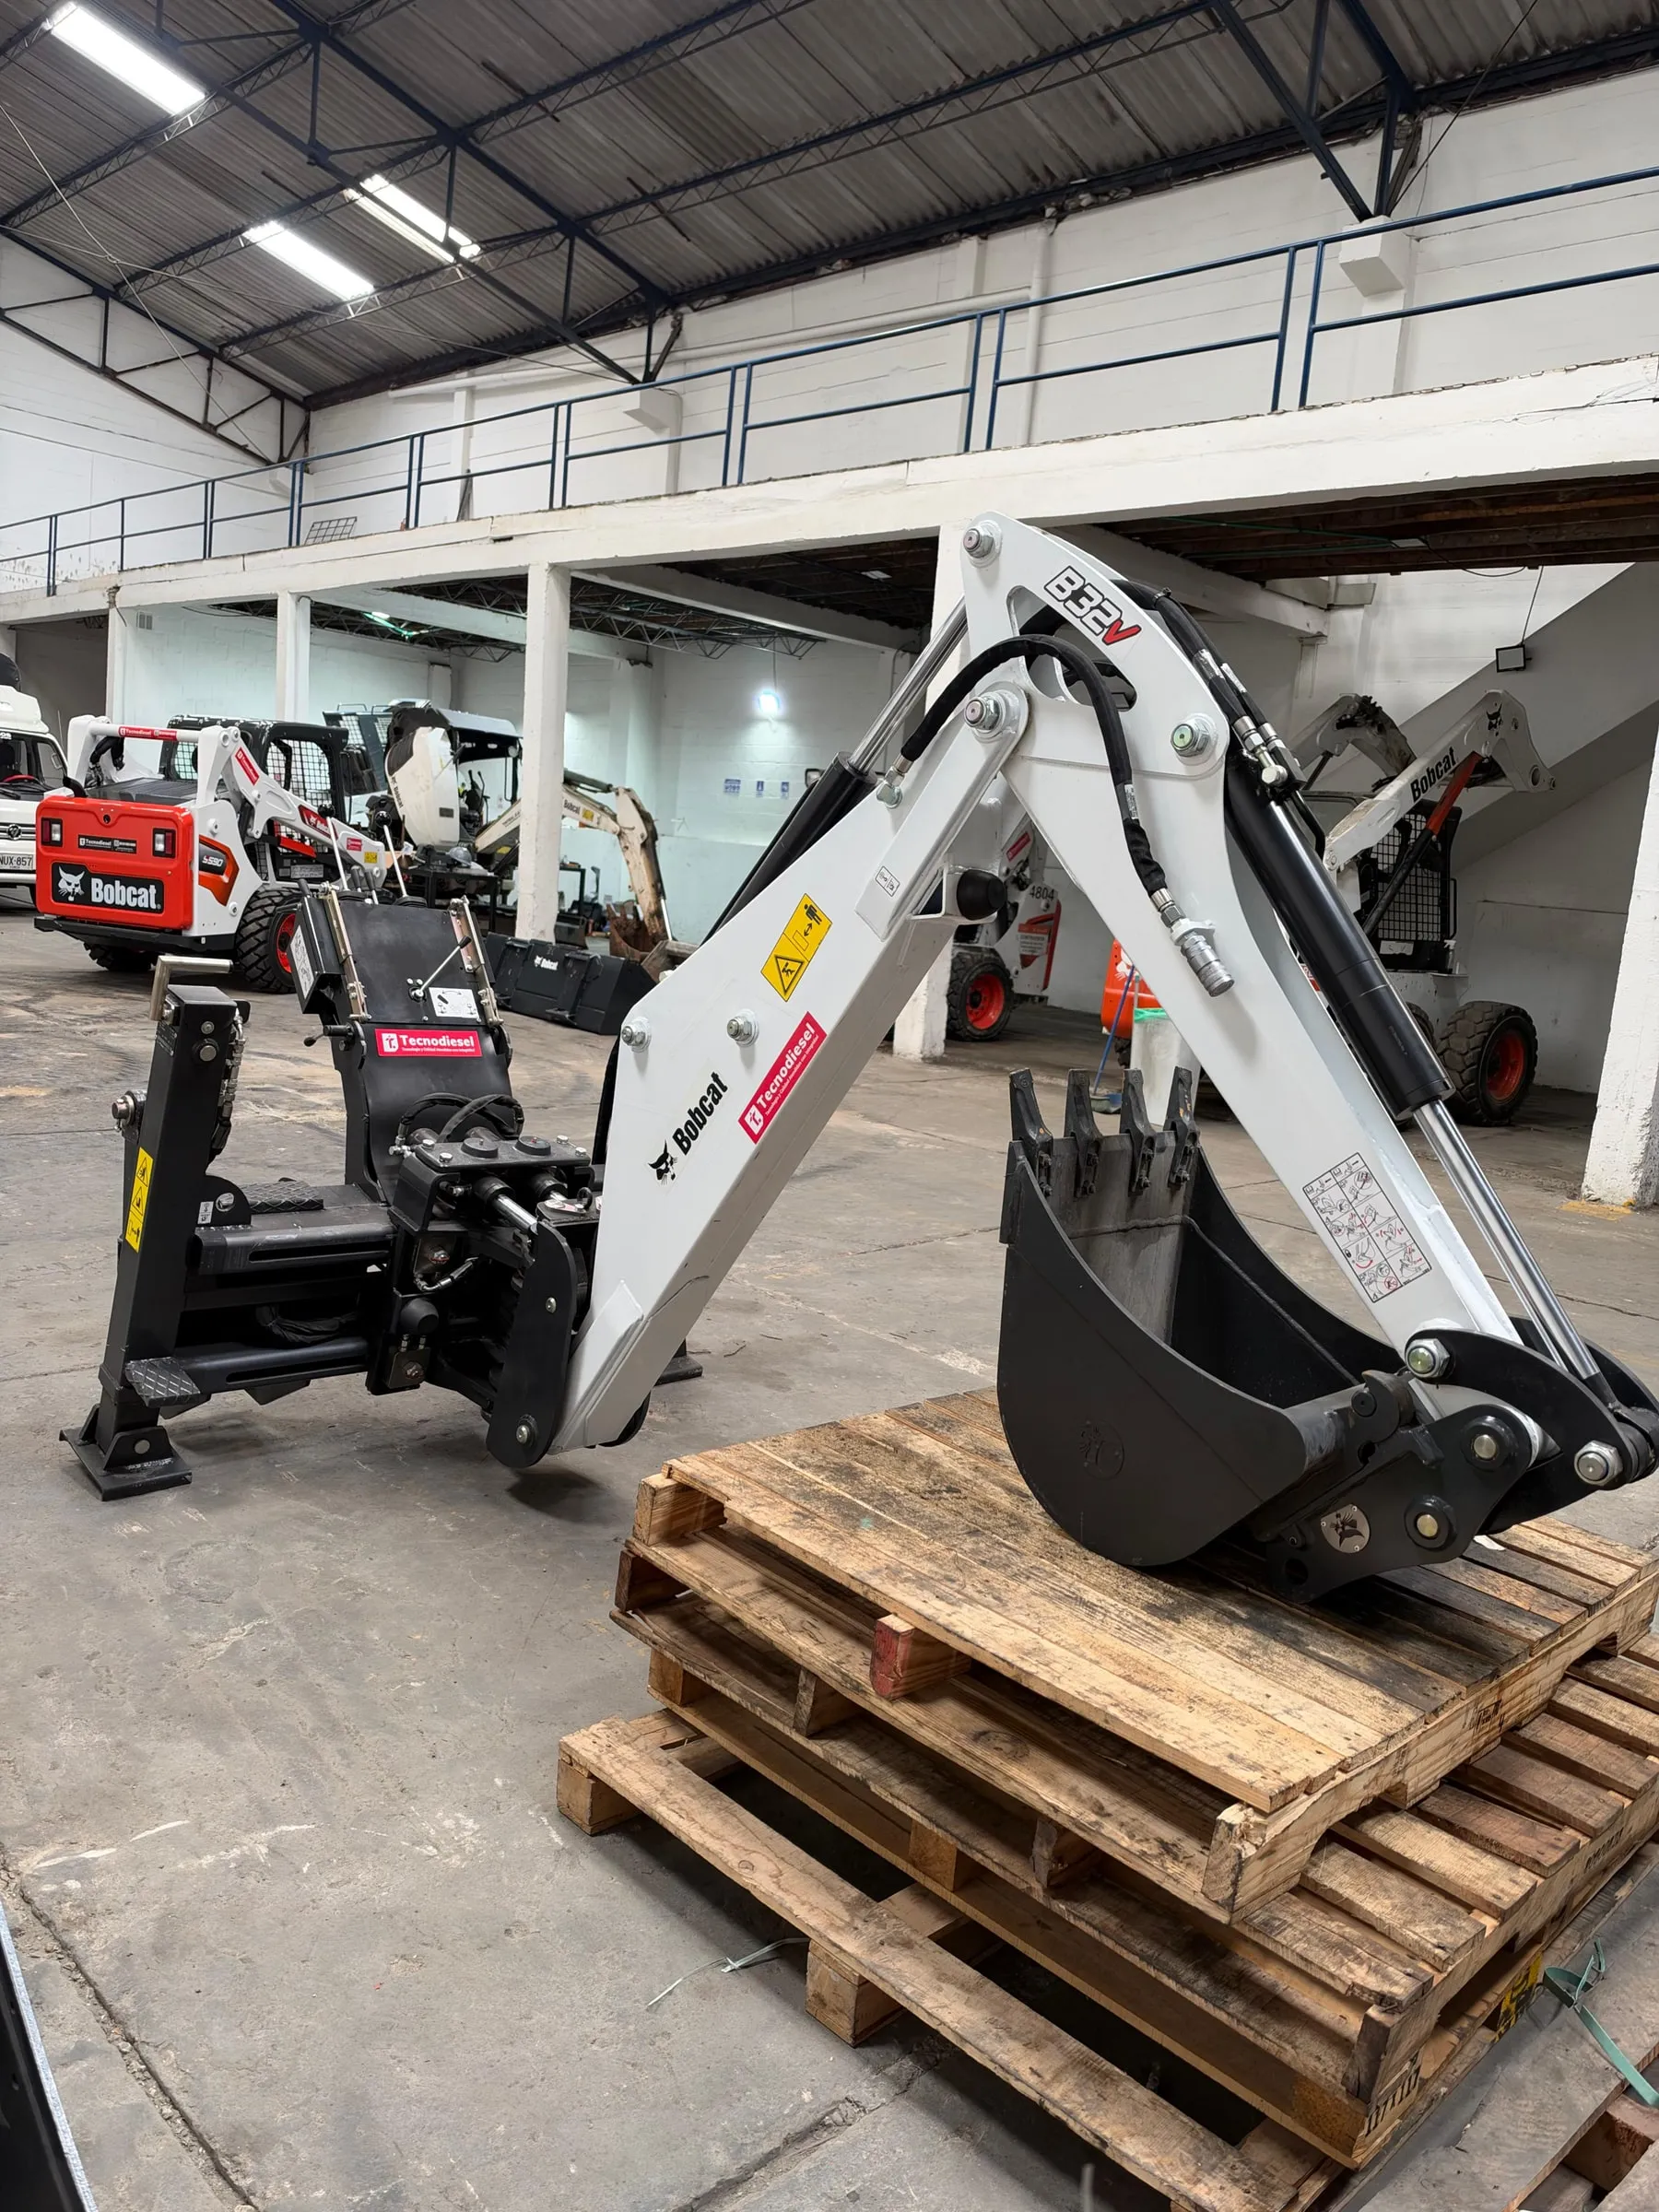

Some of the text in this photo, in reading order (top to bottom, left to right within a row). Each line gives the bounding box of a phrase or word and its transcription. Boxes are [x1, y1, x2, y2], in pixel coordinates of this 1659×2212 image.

[1410, 746, 1456, 803] Bobcat
[90, 877, 157, 910] Bobcat
[1030, 886, 1055, 900] 4804
[399, 1034, 475, 1047] Tecnodiesel
[757, 1022, 815, 1109] Tecnodiesel
[672, 1071, 728, 1156] Bobcat
